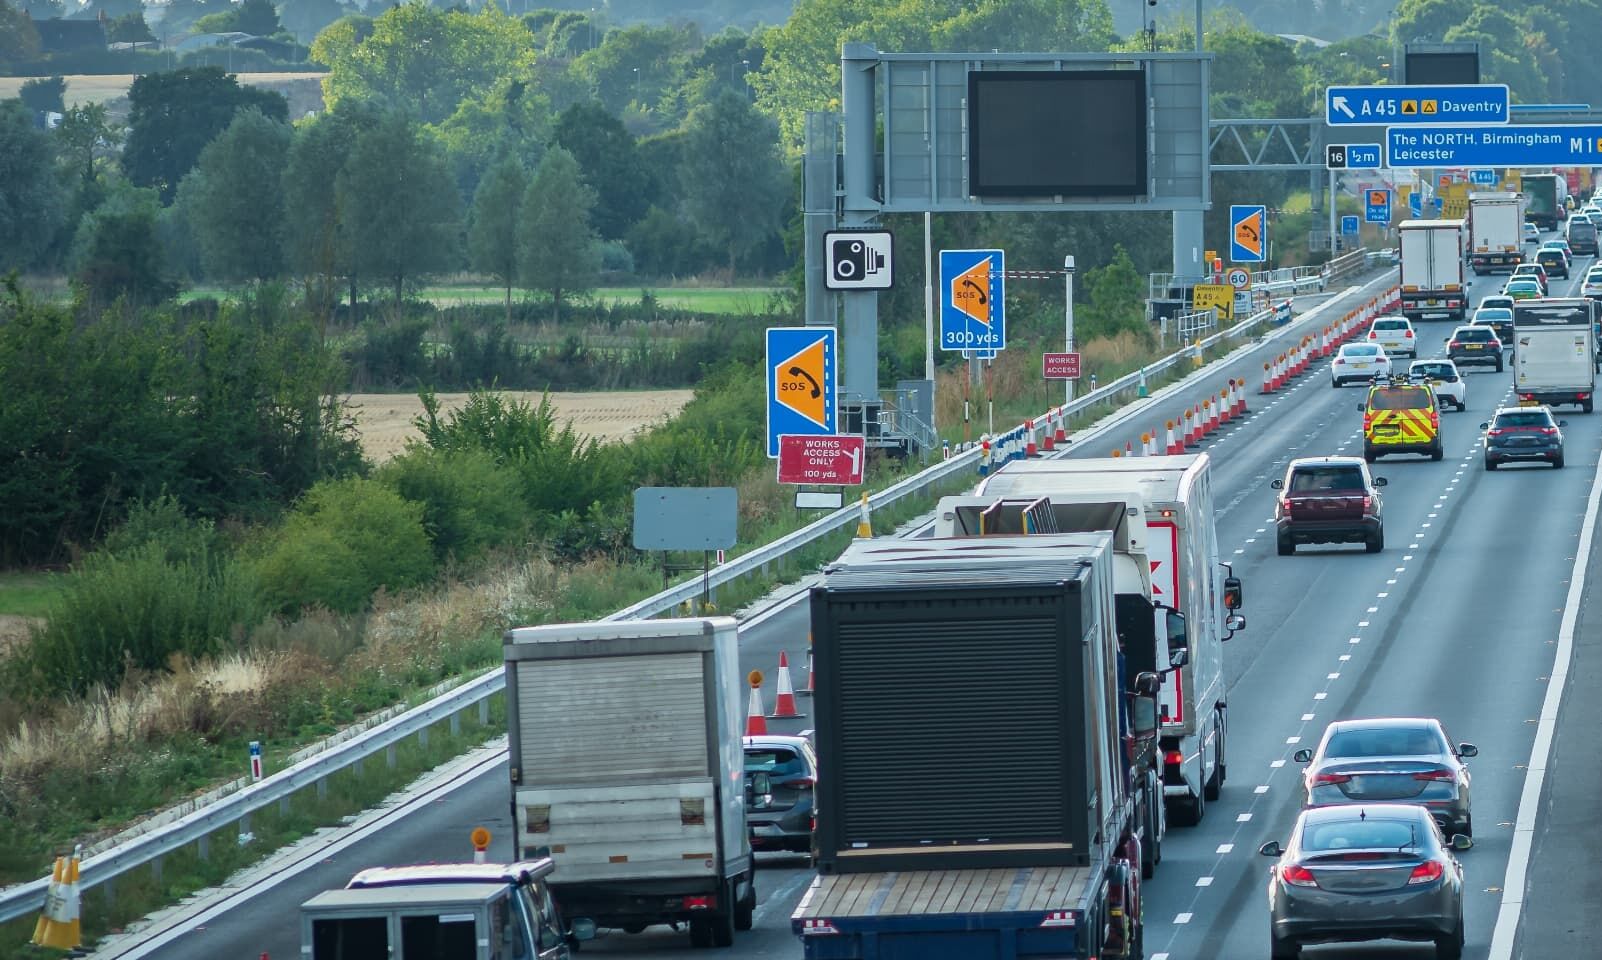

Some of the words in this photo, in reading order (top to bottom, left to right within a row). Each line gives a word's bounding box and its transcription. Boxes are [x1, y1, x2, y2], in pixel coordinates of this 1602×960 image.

[1442, 100, 1502, 114] Daventry
[1393, 133, 1417, 145] The
[1482, 133, 1562, 146] Birmingham
[1330, 152, 1344, 162] 16
[1394, 148, 1455, 160] Leicester
[1231, 274, 1246, 283] 60
[956, 291, 975, 299] SOS
[946, 331, 974, 344] 300
[781, 382, 806, 391] SOS
[805, 440, 840, 448] WORKS
[803, 449, 841, 457] ACCESS
[804, 470, 820, 478] 100
[822, 470, 837, 479] yds
